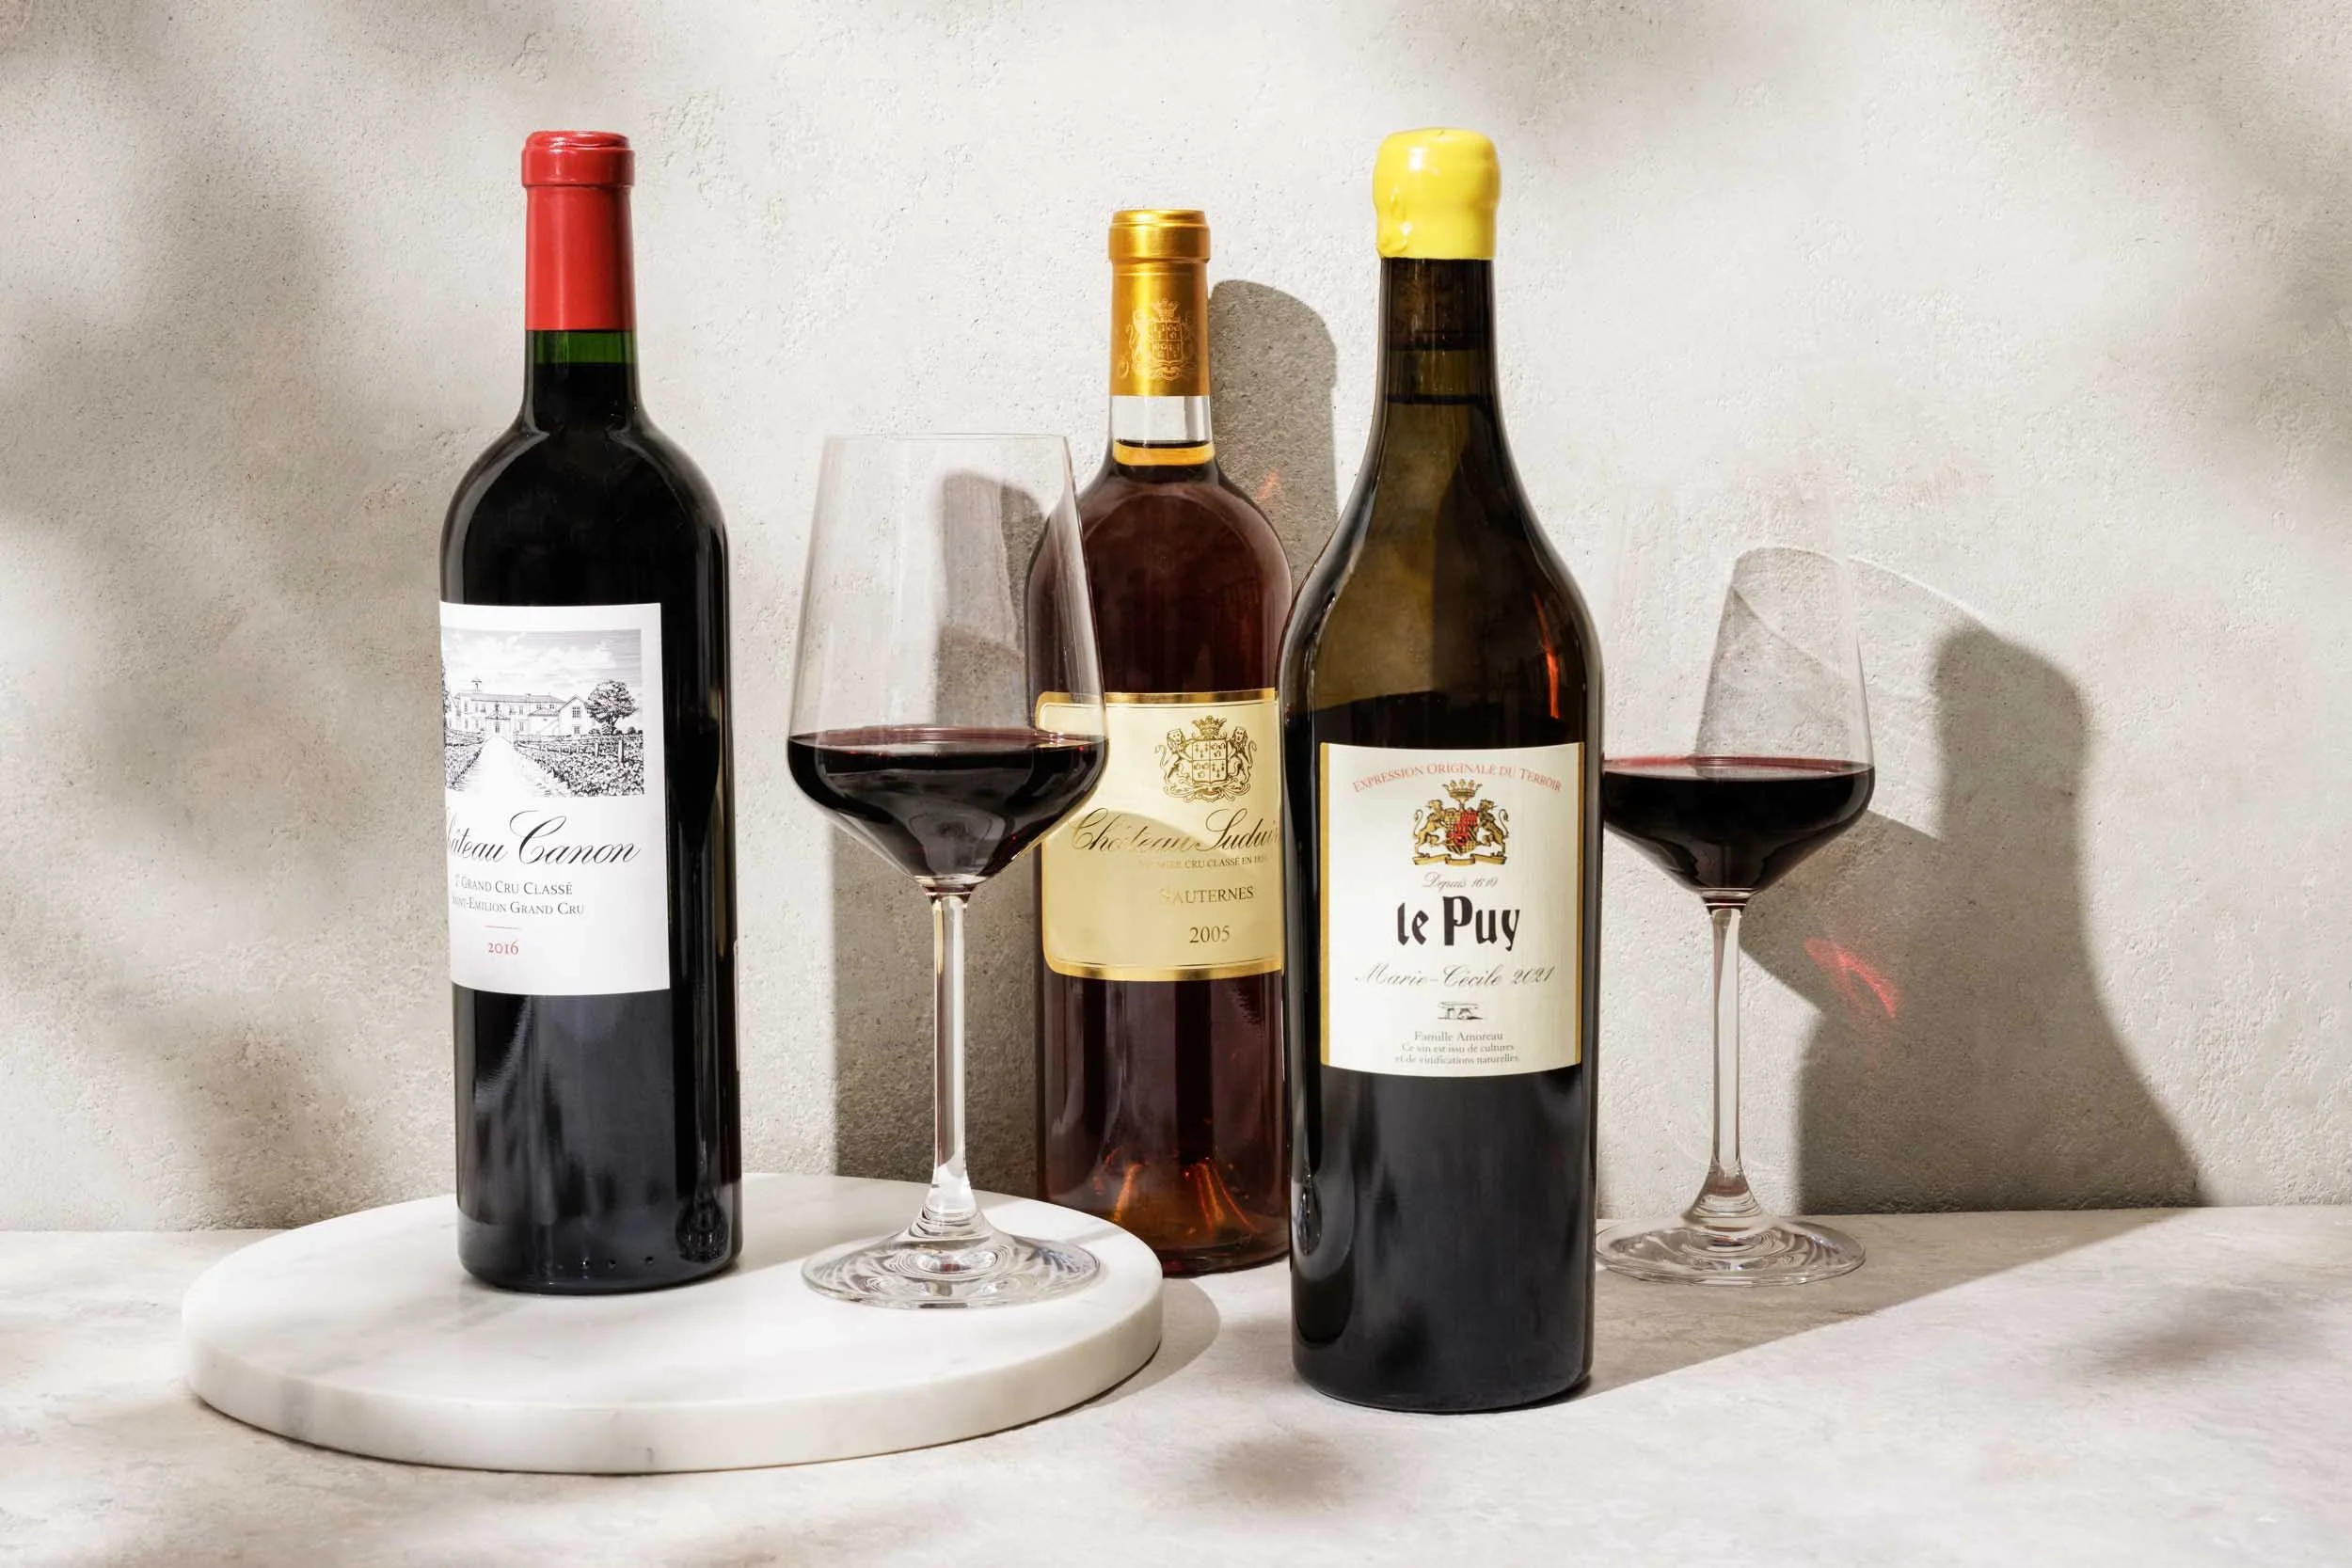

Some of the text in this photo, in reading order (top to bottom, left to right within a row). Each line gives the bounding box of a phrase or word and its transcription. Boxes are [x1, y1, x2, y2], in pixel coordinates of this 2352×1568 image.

[1354, 763, 1562, 792] EXPRESSION ORIGINALE DU TERROIR
[509, 810, 642, 864] Canon
[1184, 860, 1205, 869] CRU
[1242, 856, 1252, 865] EN
[461, 875, 492, 893] GRAND
[495, 880, 519, 895] CRU
[523, 881, 573, 895] CLASSÉ
[1421, 871, 1467, 894] Depuis
[510, 901, 554, 915] GRAND
[557, 902, 584, 915] CRU
[1397, 895, 1520, 952] le Puy
[1188, 925, 1231, 943] 2005
[487, 941, 519, 955] 2016
[1512, 966, 1555, 985] 2021
[1414, 1031, 1503, 1042] Famille Amoreau
[1402, 1042, 1415, 1052] Ce
[1417, 1044, 1431, 1053] vin
[1433, 1044, 1446, 1053] est
[1468, 1043, 1478, 1053] de
[1481, 1042, 1515, 1053] cultures
[1406, 1054, 1416, 1063] de
